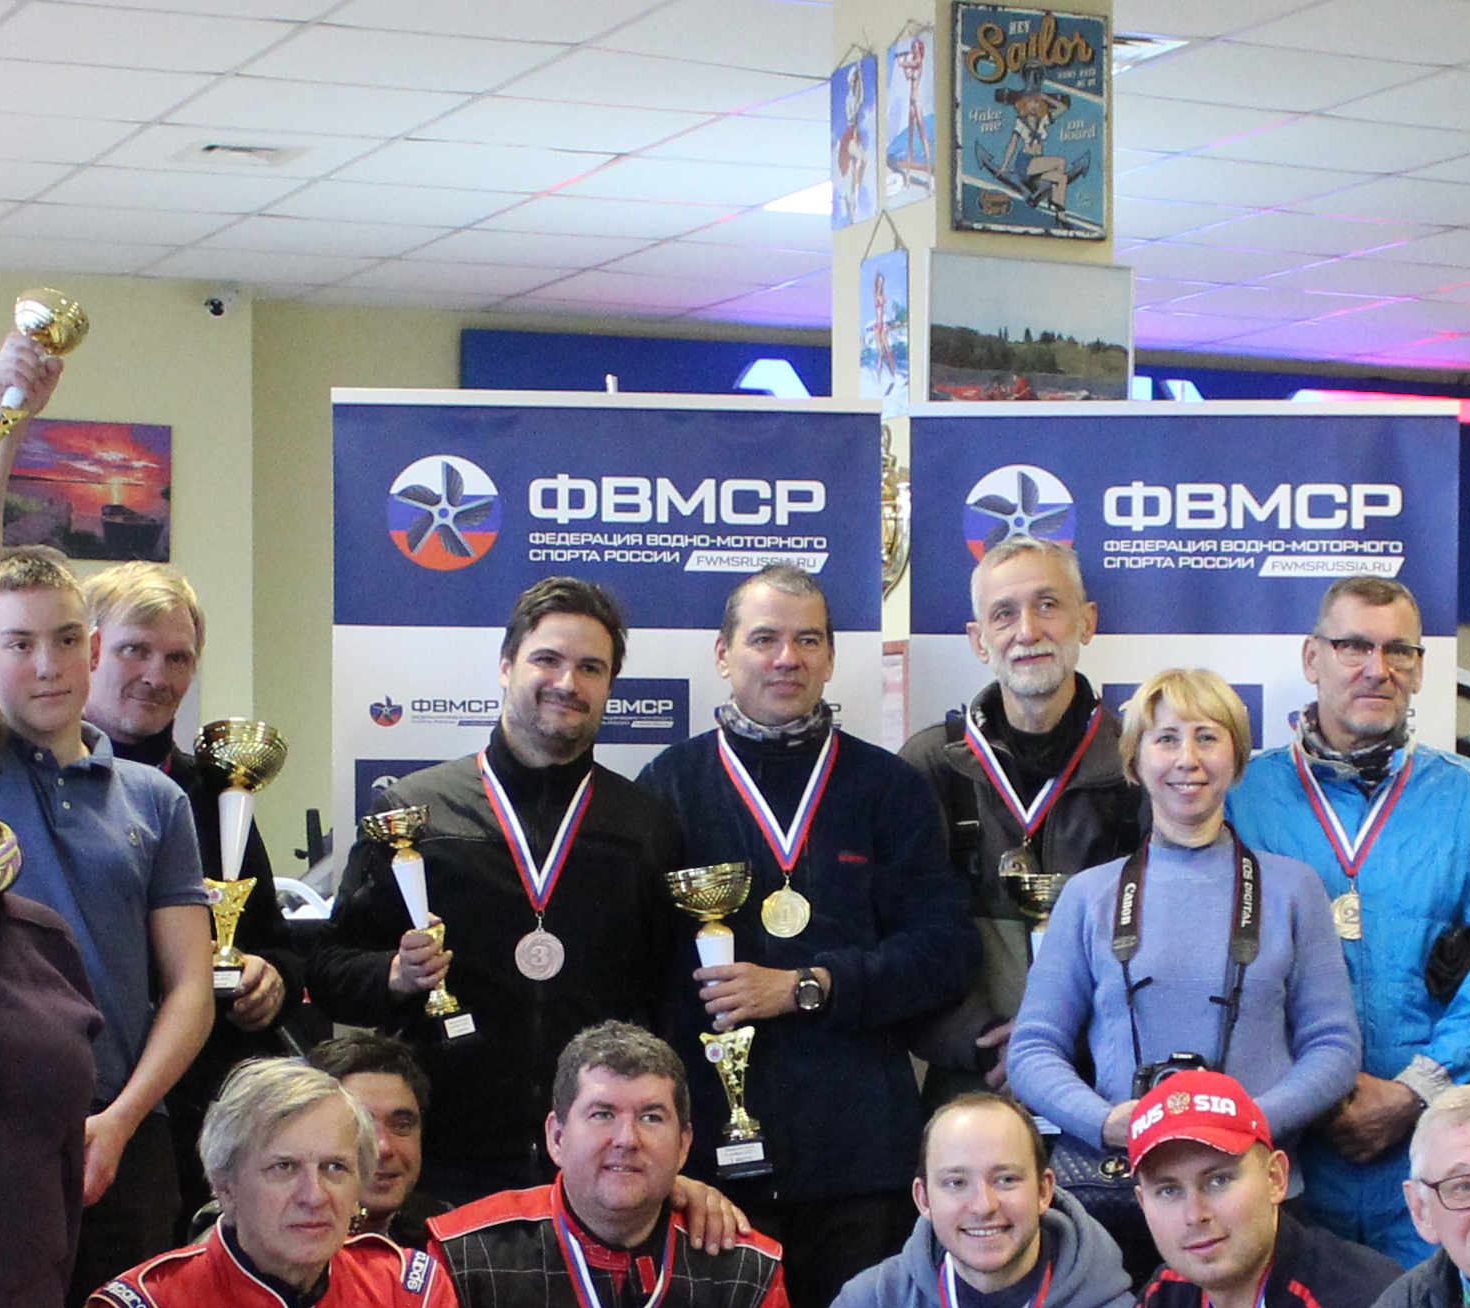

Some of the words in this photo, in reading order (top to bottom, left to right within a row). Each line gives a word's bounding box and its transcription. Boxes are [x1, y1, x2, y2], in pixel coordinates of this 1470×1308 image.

[966, 15, 1094, 83] Sailor
[529, 474, 827, 525] ФВМСР
[1103, 481, 1403, 532] ФВМСР
[529, 533, 642, 546] ФЕДЕРАЦИЯ
[647, 534, 827, 549] ВОДНО-МОТОРНОГО
[1103, 540, 1217, 553] ФЕДЕРАЦИЯ
[1220, 541, 1403, 553] ВОДНО-МОТОРНОГО
[529, 550, 601, 562] СПОРТА
[604, 550, 680, 563] РОССИИ
[1103, 556, 1175, 568] СПОРТА
[1178, 556, 1255, 569] РОССИИ
[1271, 561, 1392, 572] FWMSRUSSIA.RU
[411, 699, 499, 713] ФВМСР
[605, 699, 674, 714] ВМСР
[1242, 857, 1254, 881] EOS
[1120, 882, 1137, 925] Canon
[1241, 882, 1254, 928] DIGITAL
[1131, 1103, 1165, 1140] RUS
[1193, 1094, 1237, 1116] SIA
